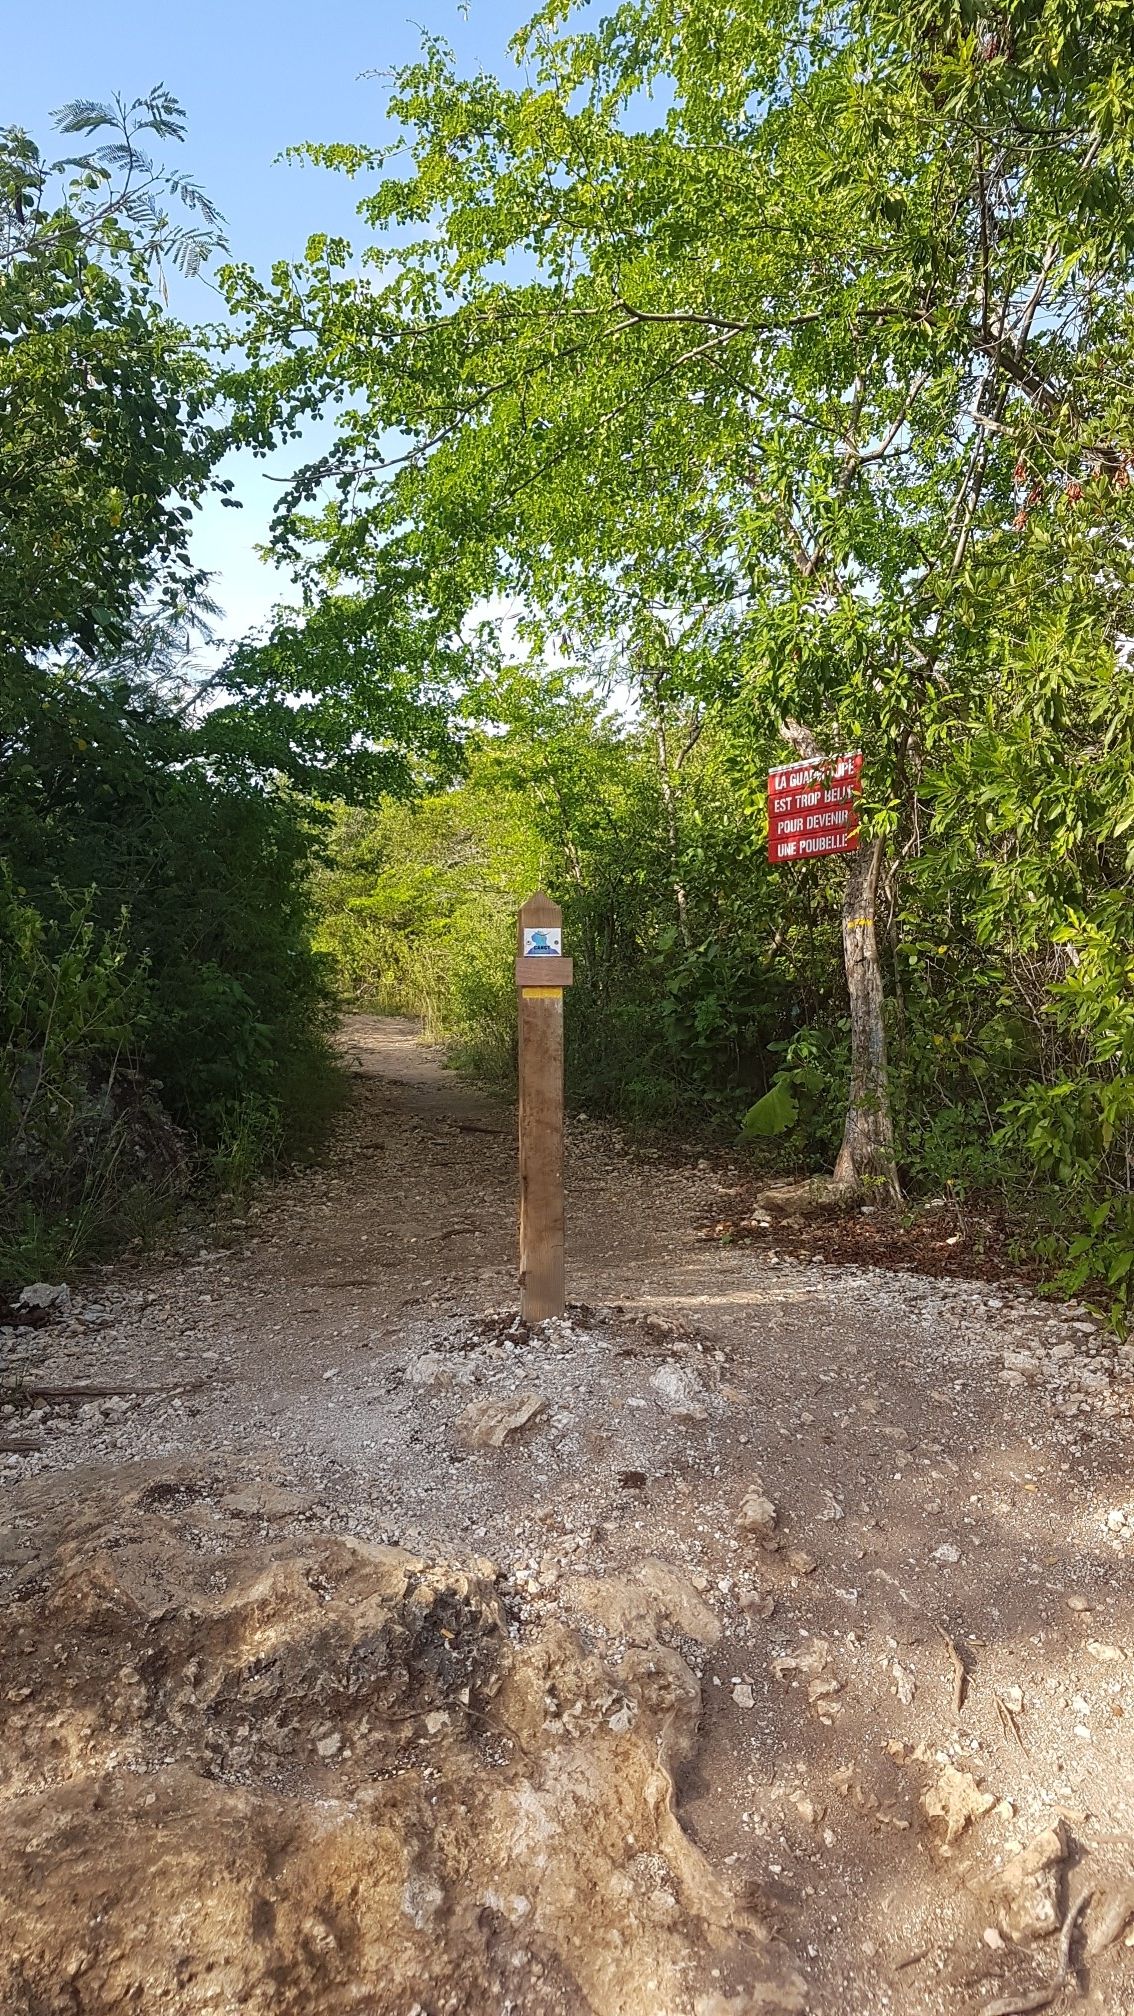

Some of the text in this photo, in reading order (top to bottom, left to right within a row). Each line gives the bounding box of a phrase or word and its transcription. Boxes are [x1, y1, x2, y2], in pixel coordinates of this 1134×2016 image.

[775, 758, 854, 790] LA GUAUPE
[774, 797, 792, 813] EST
[795, 791, 821, 808] TROP
[777, 809, 848, 835] POUR DEVENIR
[777, 833, 848, 858] UNE POUBELLE
